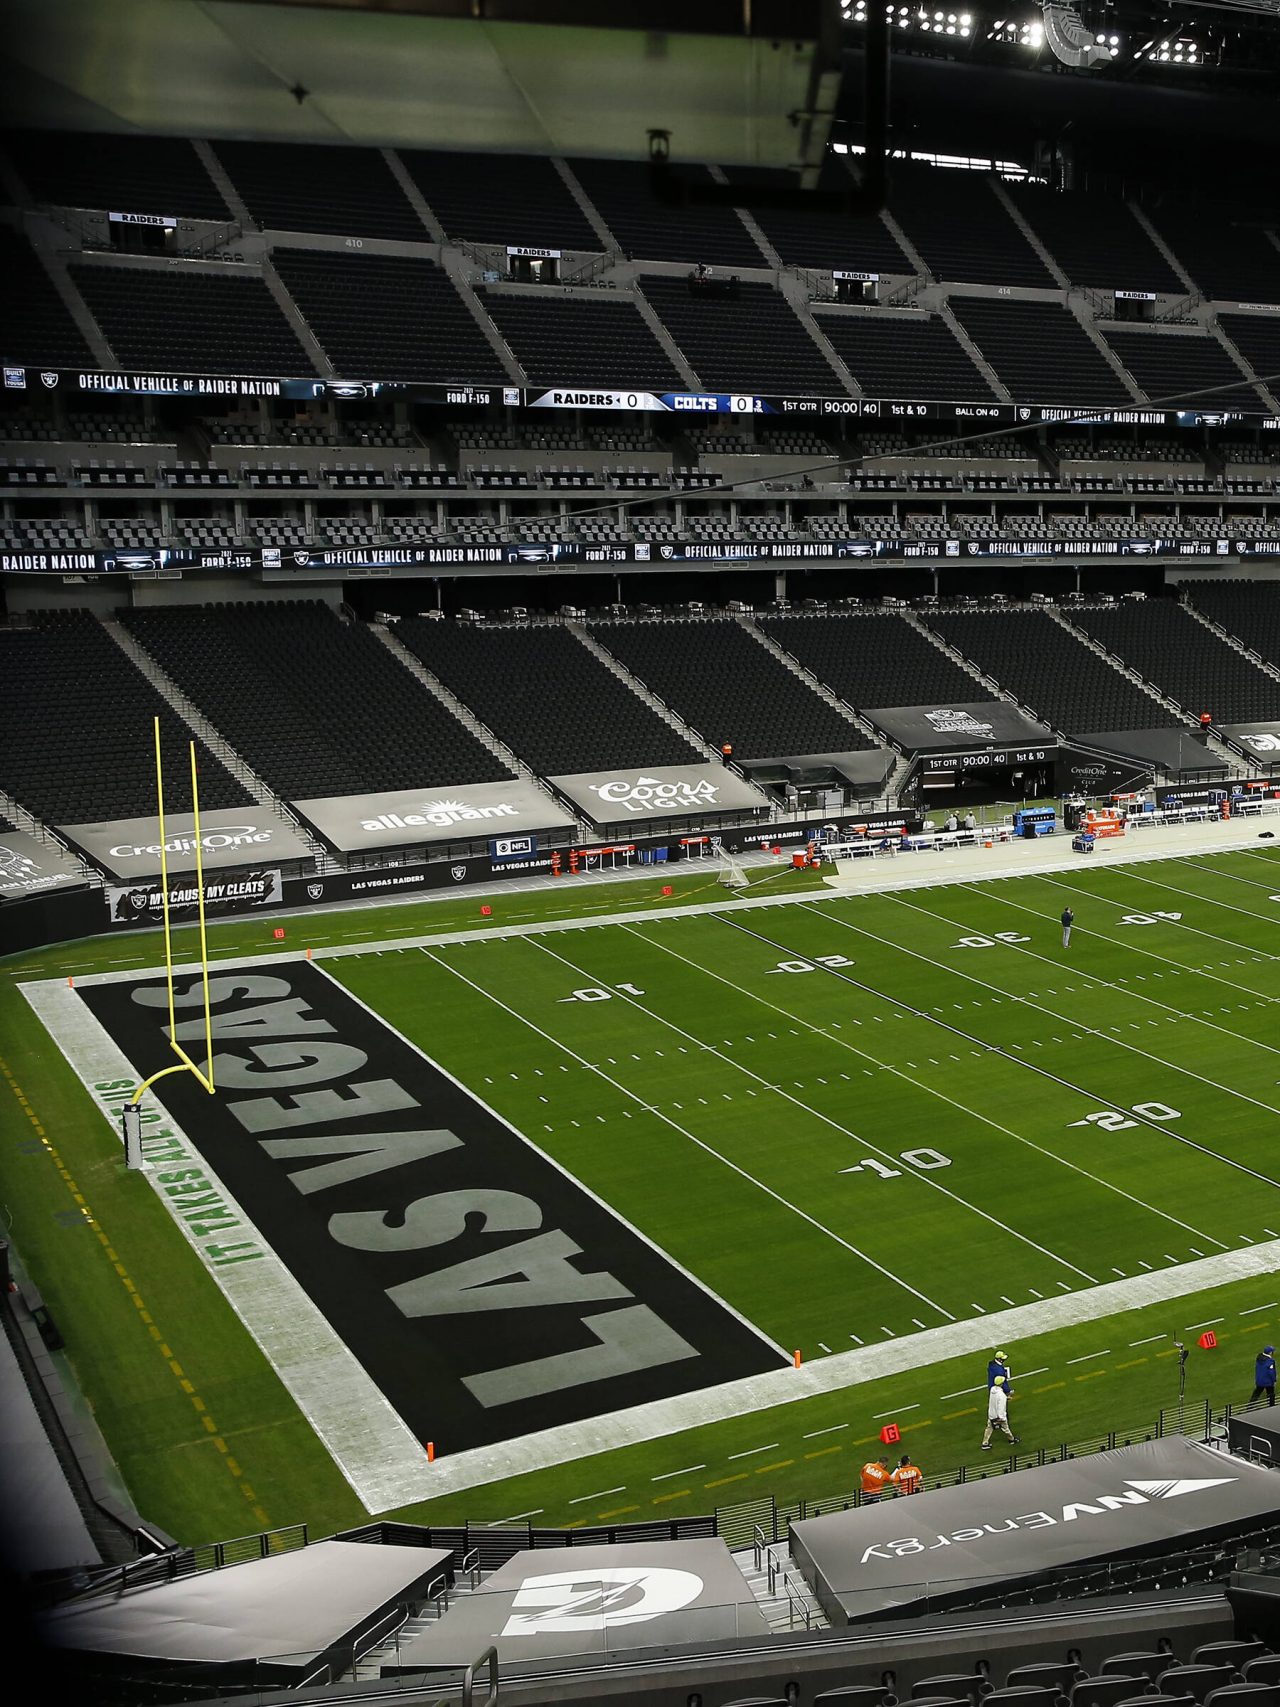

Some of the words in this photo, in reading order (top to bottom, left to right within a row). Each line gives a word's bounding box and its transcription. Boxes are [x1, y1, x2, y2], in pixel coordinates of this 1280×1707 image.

[122, 215, 164, 225] RAIDERS
[345, 240, 363, 248] 410
[517, 247, 551, 257] RAIDERS
[842, 272, 870, 280] RAIDERS
[1123, 292, 1148, 300] RAIDERS
[79, 374, 130, 390] OFFICIAL
[133, 377, 178, 392] VEHICLE
[183, 381, 194, 391] OF
[198, 379, 238, 394] RAIDER
[240, 381, 280, 396] NATION
[447, 393, 466, 404] FORD
[469, 393, 490, 405] F-150
[553, 393, 613, 407] RAIDERS
[626, 394, 638, 408] 0
[674, 397, 717, 410] COLTS
[736, 398, 747, 412] 0
[782, 401, 798, 411] 1ST
[824, 402, 858, 415] 90:00
[863, 403, 877, 415] 40
[891, 405, 904, 415] 1st
[906, 405, 914, 415] &
[916, 405, 927, 416] 10
[955, 407, 974, 417] BALL
[976, 408, 987, 417] ON
[989, 408, 999, 418] 40
[324, 549, 368, 564] OFFICIAL
[372, 550, 411, 564] VEHICLE
[416, 551, 425, 561] OF
[430, 549, 464, 562] RAIDER
[467, 548, 502, 562] NATION
[586, 551, 604, 561] FORD
[606, 550, 626, 561] F-150
[685, 544, 721, 558] OFFICIAL
[725, 545, 757, 558] VEHICLE
[761, 547, 768, 555] OF
[772, 544, 802, 556] RAIDER
[804, 544, 833, 556] NATION
[2, 555, 47, 571] RAIDER
[51, 554, 96, 570] NATION
[201, 556, 224, 568] FORD
[227, 557, 251, 568] F-150
[930, 760, 942, 769] 1ST
[963, 755, 989, 767] 90:00
[994, 754, 1005, 764] 40
[1016, 753, 1027, 762] 1st
[1028, 752, 1035, 761] &
[1037, 752, 1045, 760] 10
[589, 780, 719, 804] Coors
[622, 793, 718, 813] LIGHT
[360, 802, 520, 832] allegiant
[869, 821, 887, 829] VEGAS
[511, 840, 530, 850] NFL
[745, 835, 756, 843] LAS
[757, 833, 777, 841] VEGAS
[777, 831, 803, 840] RAIDERS
[492, 864, 506, 872] LAS
[507, 862, 529, 871] VEGAS
[351, 881, 366, 890] LAS
[367, 878, 392, 888] VEGAS
[393, 875, 424, 886] RAIDERS
[170, 887, 206, 903] CAUS
[207, 886, 226, 898] MY
[227, 881, 264, 896] CLEATS
[1121, 911, 1183, 926] 40
[958, 931, 1032, 949] 30
[776, 953, 857, 974] 20
[571, 983, 647, 1002] 10
[94, 1079, 143, 1102] US
[131, 974, 465, 1195] VEGAS
[1085, 1101, 1183, 1133] 20
[141, 1129, 193, 1163] ALL
[859, 1147, 953, 1179] 10
[157, 1168, 242, 1238] TAKES
[205, 1241, 266, 1265] IT
[328, 1188, 700, 1409] LAS
